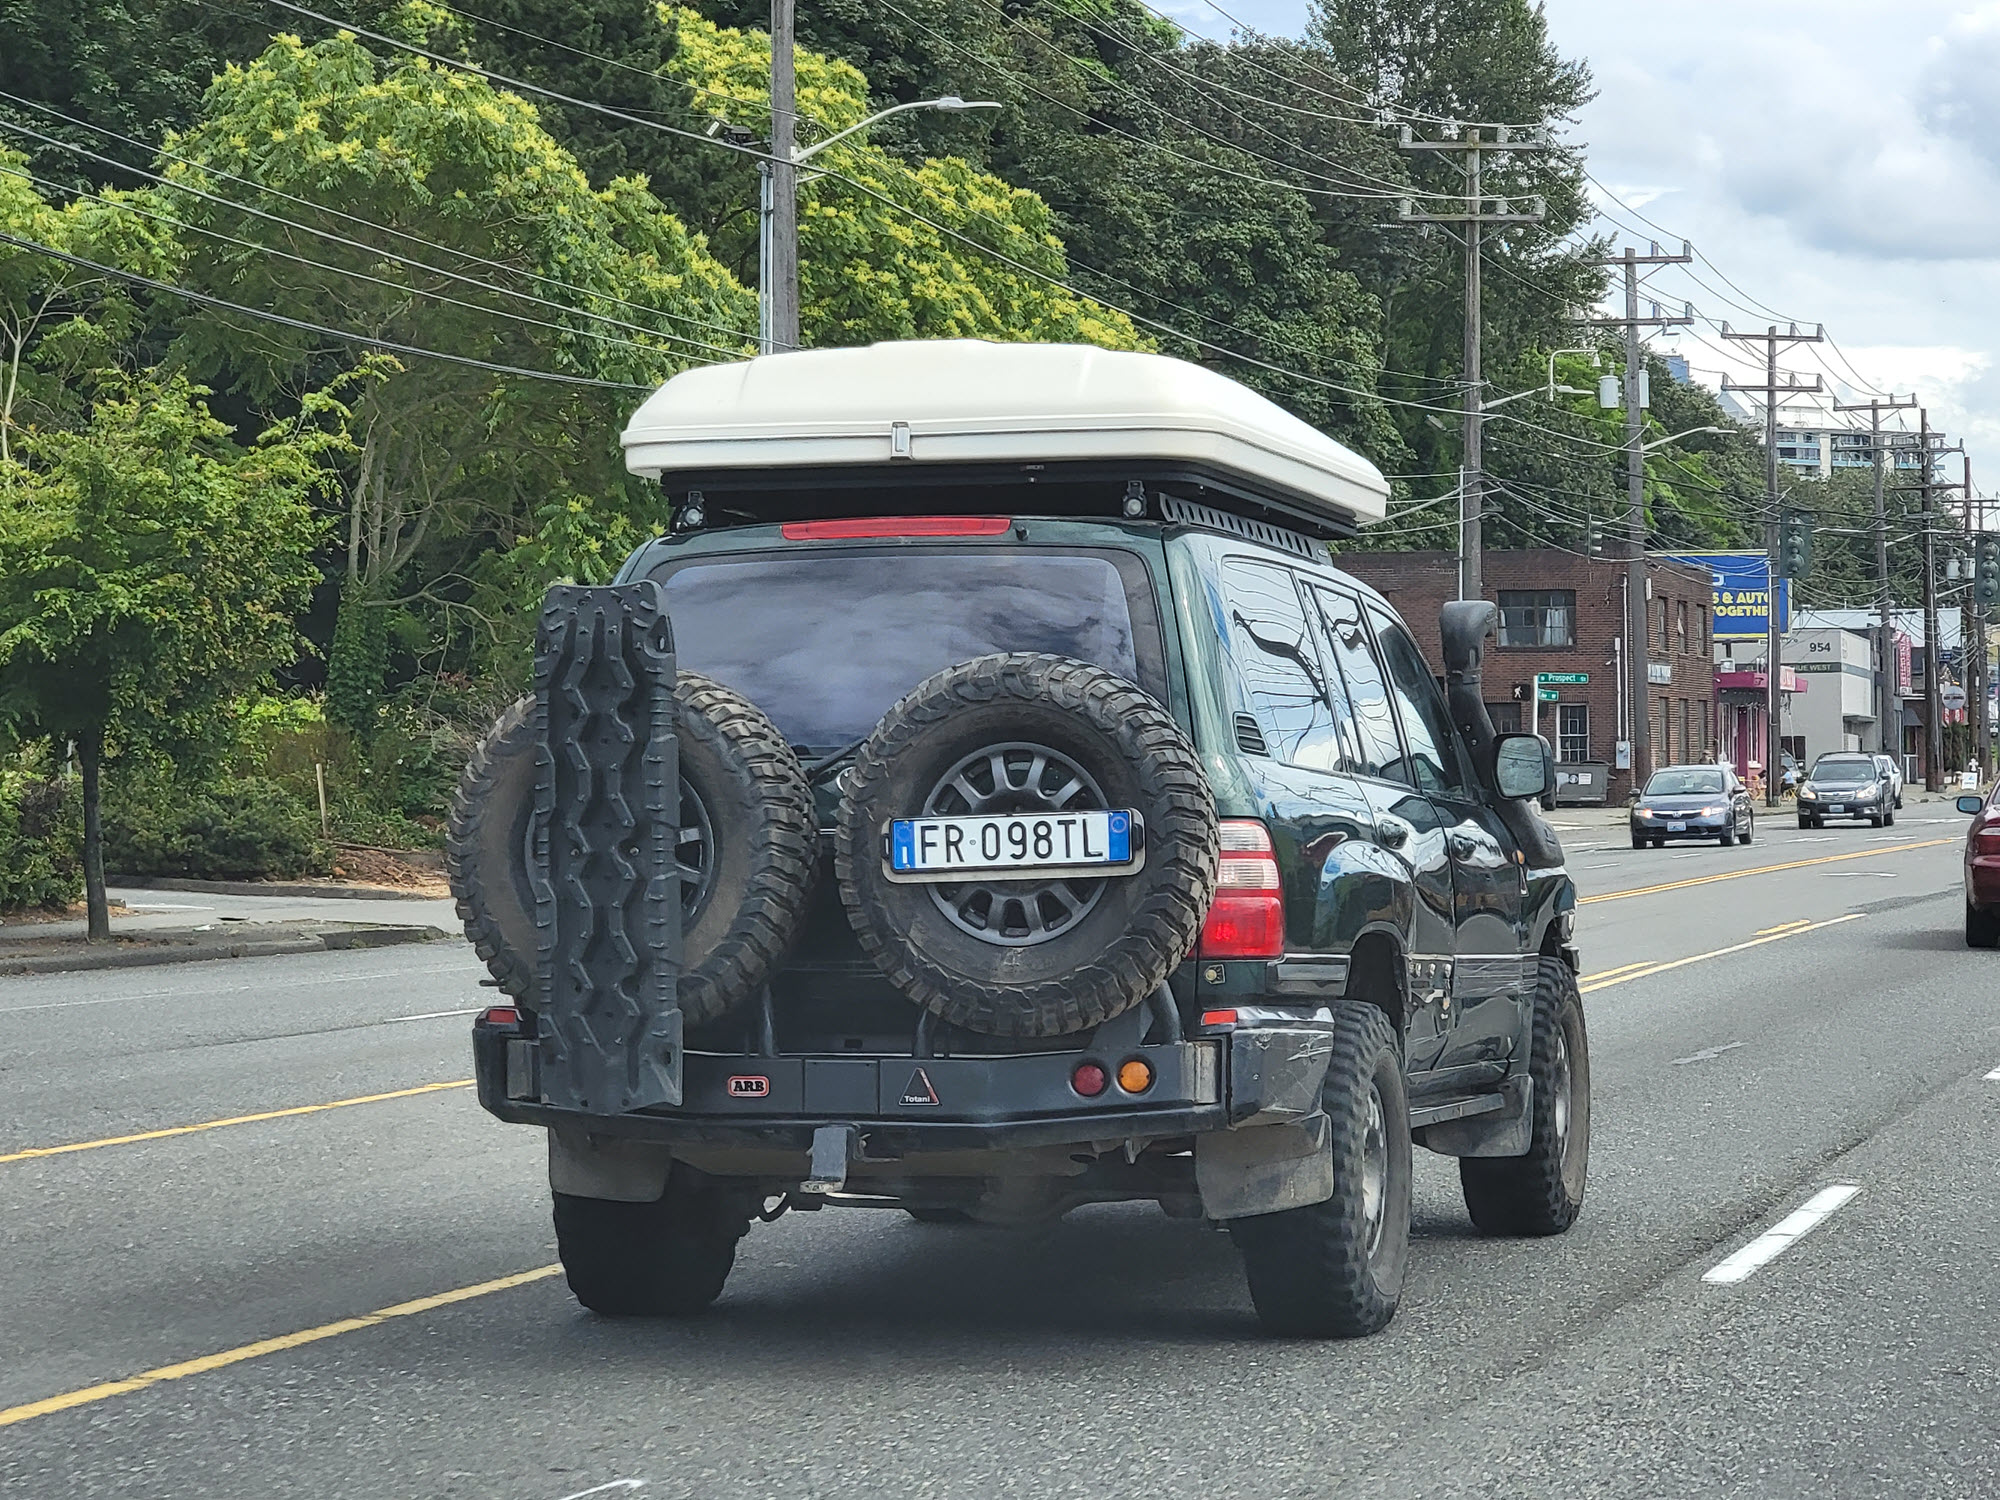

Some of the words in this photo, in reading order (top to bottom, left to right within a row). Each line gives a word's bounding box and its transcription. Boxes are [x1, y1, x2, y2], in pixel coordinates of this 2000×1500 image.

[1722, 592, 1733, 604] &
[1809, 642, 1831, 652] 954
[1548, 673, 1576, 683] Prospect
[920, 824, 965, 864] FR
[981, 818, 1104, 861] 098TL
[733, 1081, 765, 1092] ARB
[904, 1095, 931, 1103] Totani
